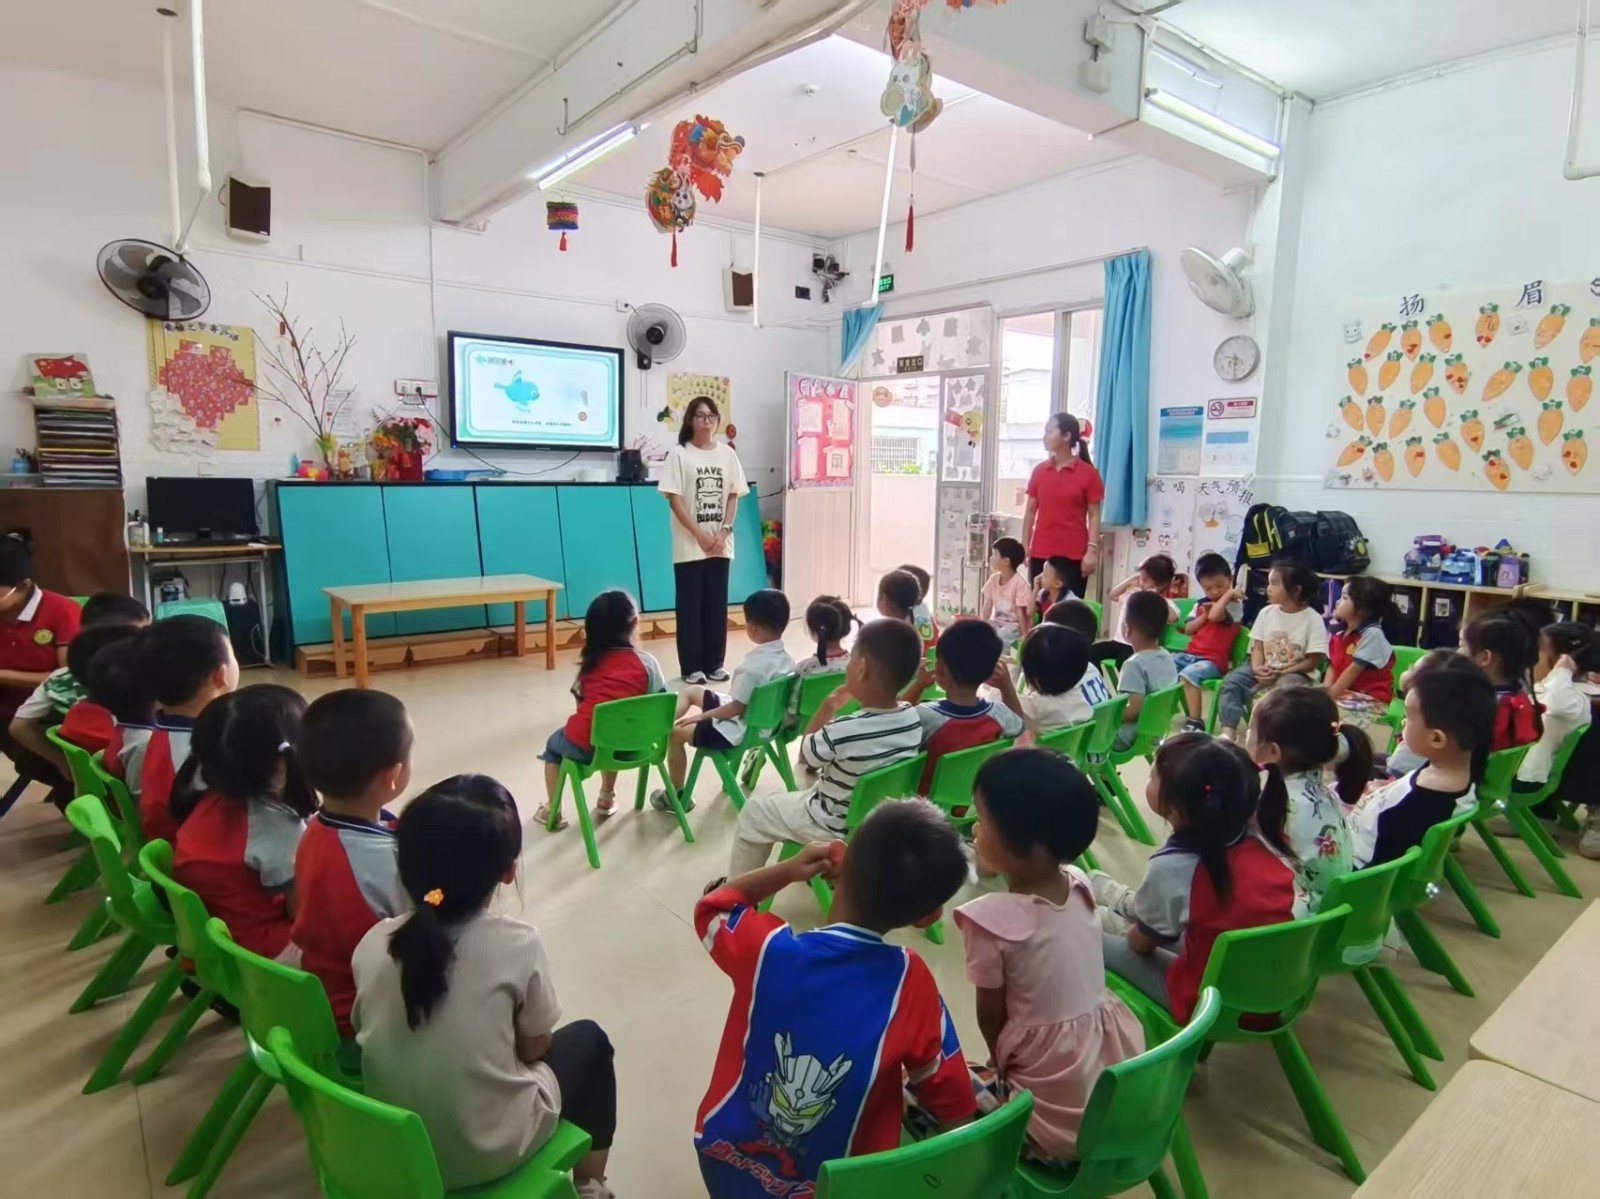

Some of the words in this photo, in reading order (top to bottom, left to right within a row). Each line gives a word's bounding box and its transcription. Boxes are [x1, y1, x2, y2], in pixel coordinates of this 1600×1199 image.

[1399, 293, 1425, 316] 扬
[1515, 280, 1543, 307] 眉
[696, 466, 723, 476] HAVE
[1197, 479, 1254, 506] 天气预报
